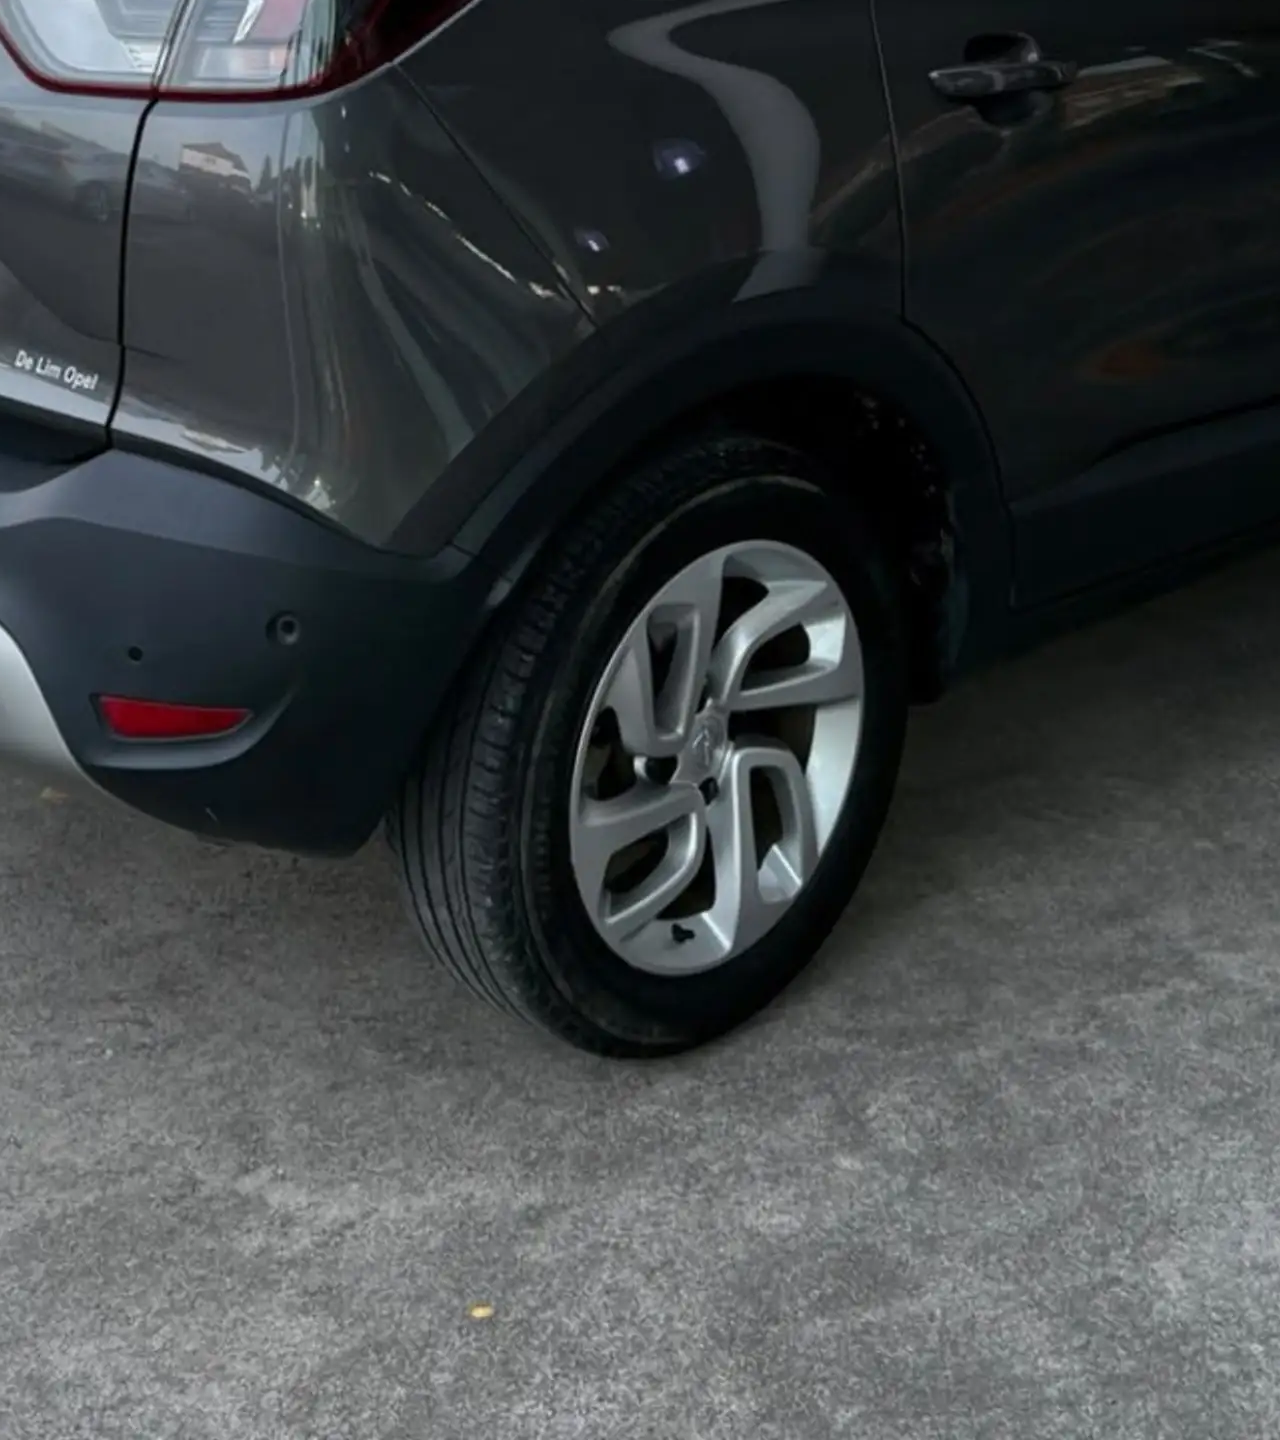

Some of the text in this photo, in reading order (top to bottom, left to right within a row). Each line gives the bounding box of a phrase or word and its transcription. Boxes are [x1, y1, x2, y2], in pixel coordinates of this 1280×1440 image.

[14, 349, 99, 391] De Lim Opel
